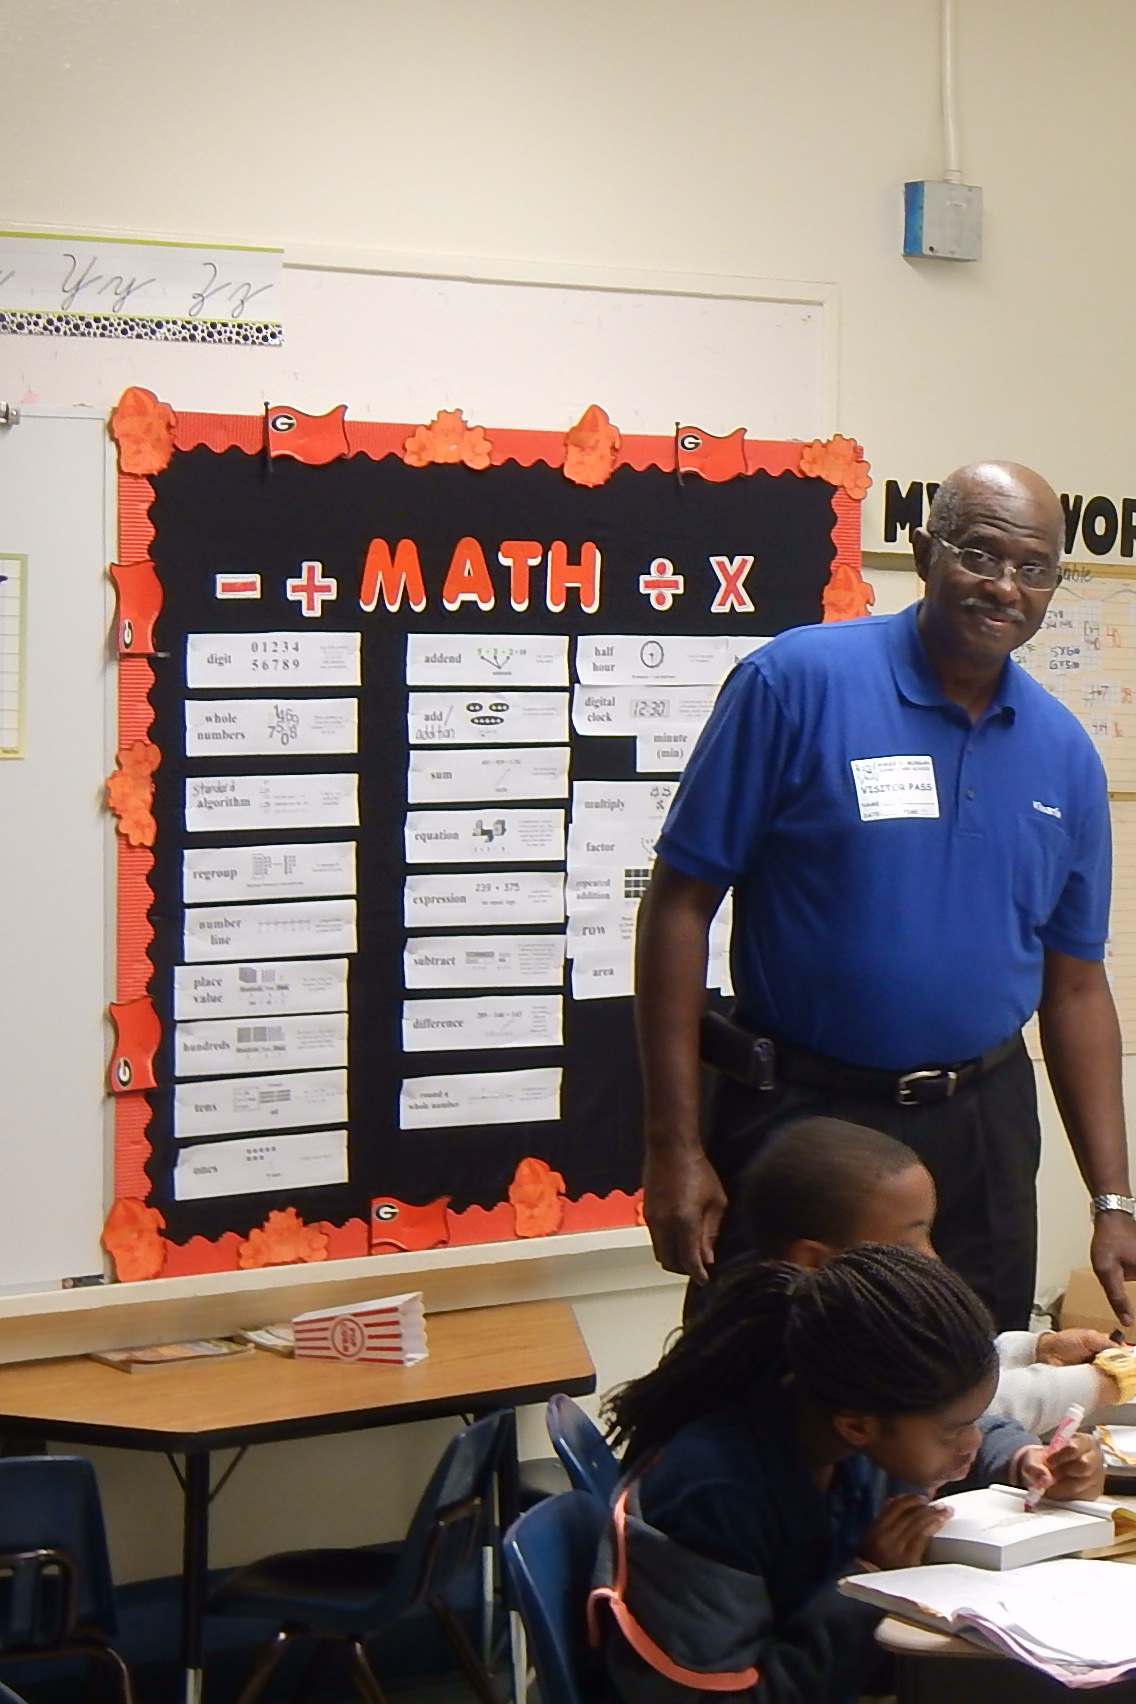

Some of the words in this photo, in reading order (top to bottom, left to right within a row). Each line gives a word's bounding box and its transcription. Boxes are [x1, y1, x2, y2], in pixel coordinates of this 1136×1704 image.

[884, 479, 940, 543] M
[359, 536, 601, 614] MATH
[594, 646, 615, 657] half
[206, 654, 232, 667] digit
[424, 653, 462, 664] addend
[592, 662, 616, 672] hour
[584, 696, 616, 709] digital
[205, 713, 238, 724] whole
[424, 711, 443, 722] add
[587, 712, 612, 722] clock
[197, 730, 246, 741] numbers
[653, 732, 688, 743] minute
[430, 771, 453, 780] sum
[860, 784, 906, 794] VISITOR
[908, 782, 933, 791] PASS
[197, 796, 251, 810] algorithm
[584, 799, 625, 811] multiply
[414, 830, 459, 843] equation
[586, 841, 615, 852] factor
[192, 868, 238, 880] regroup
[412, 893, 467, 907] expression
[199, 918, 242, 930] number
[582, 926, 606, 936] row
[210, 934, 231, 945] line
[413, 955, 456, 966] subtract
[592, 968, 615, 977] area
[193, 976, 223, 990] place
[193, 993, 223, 1004] value
[412, 1018, 464, 1029] difference
[182, 1040, 230, 1052] hundreds
[194, 1102, 218, 1113] tens
